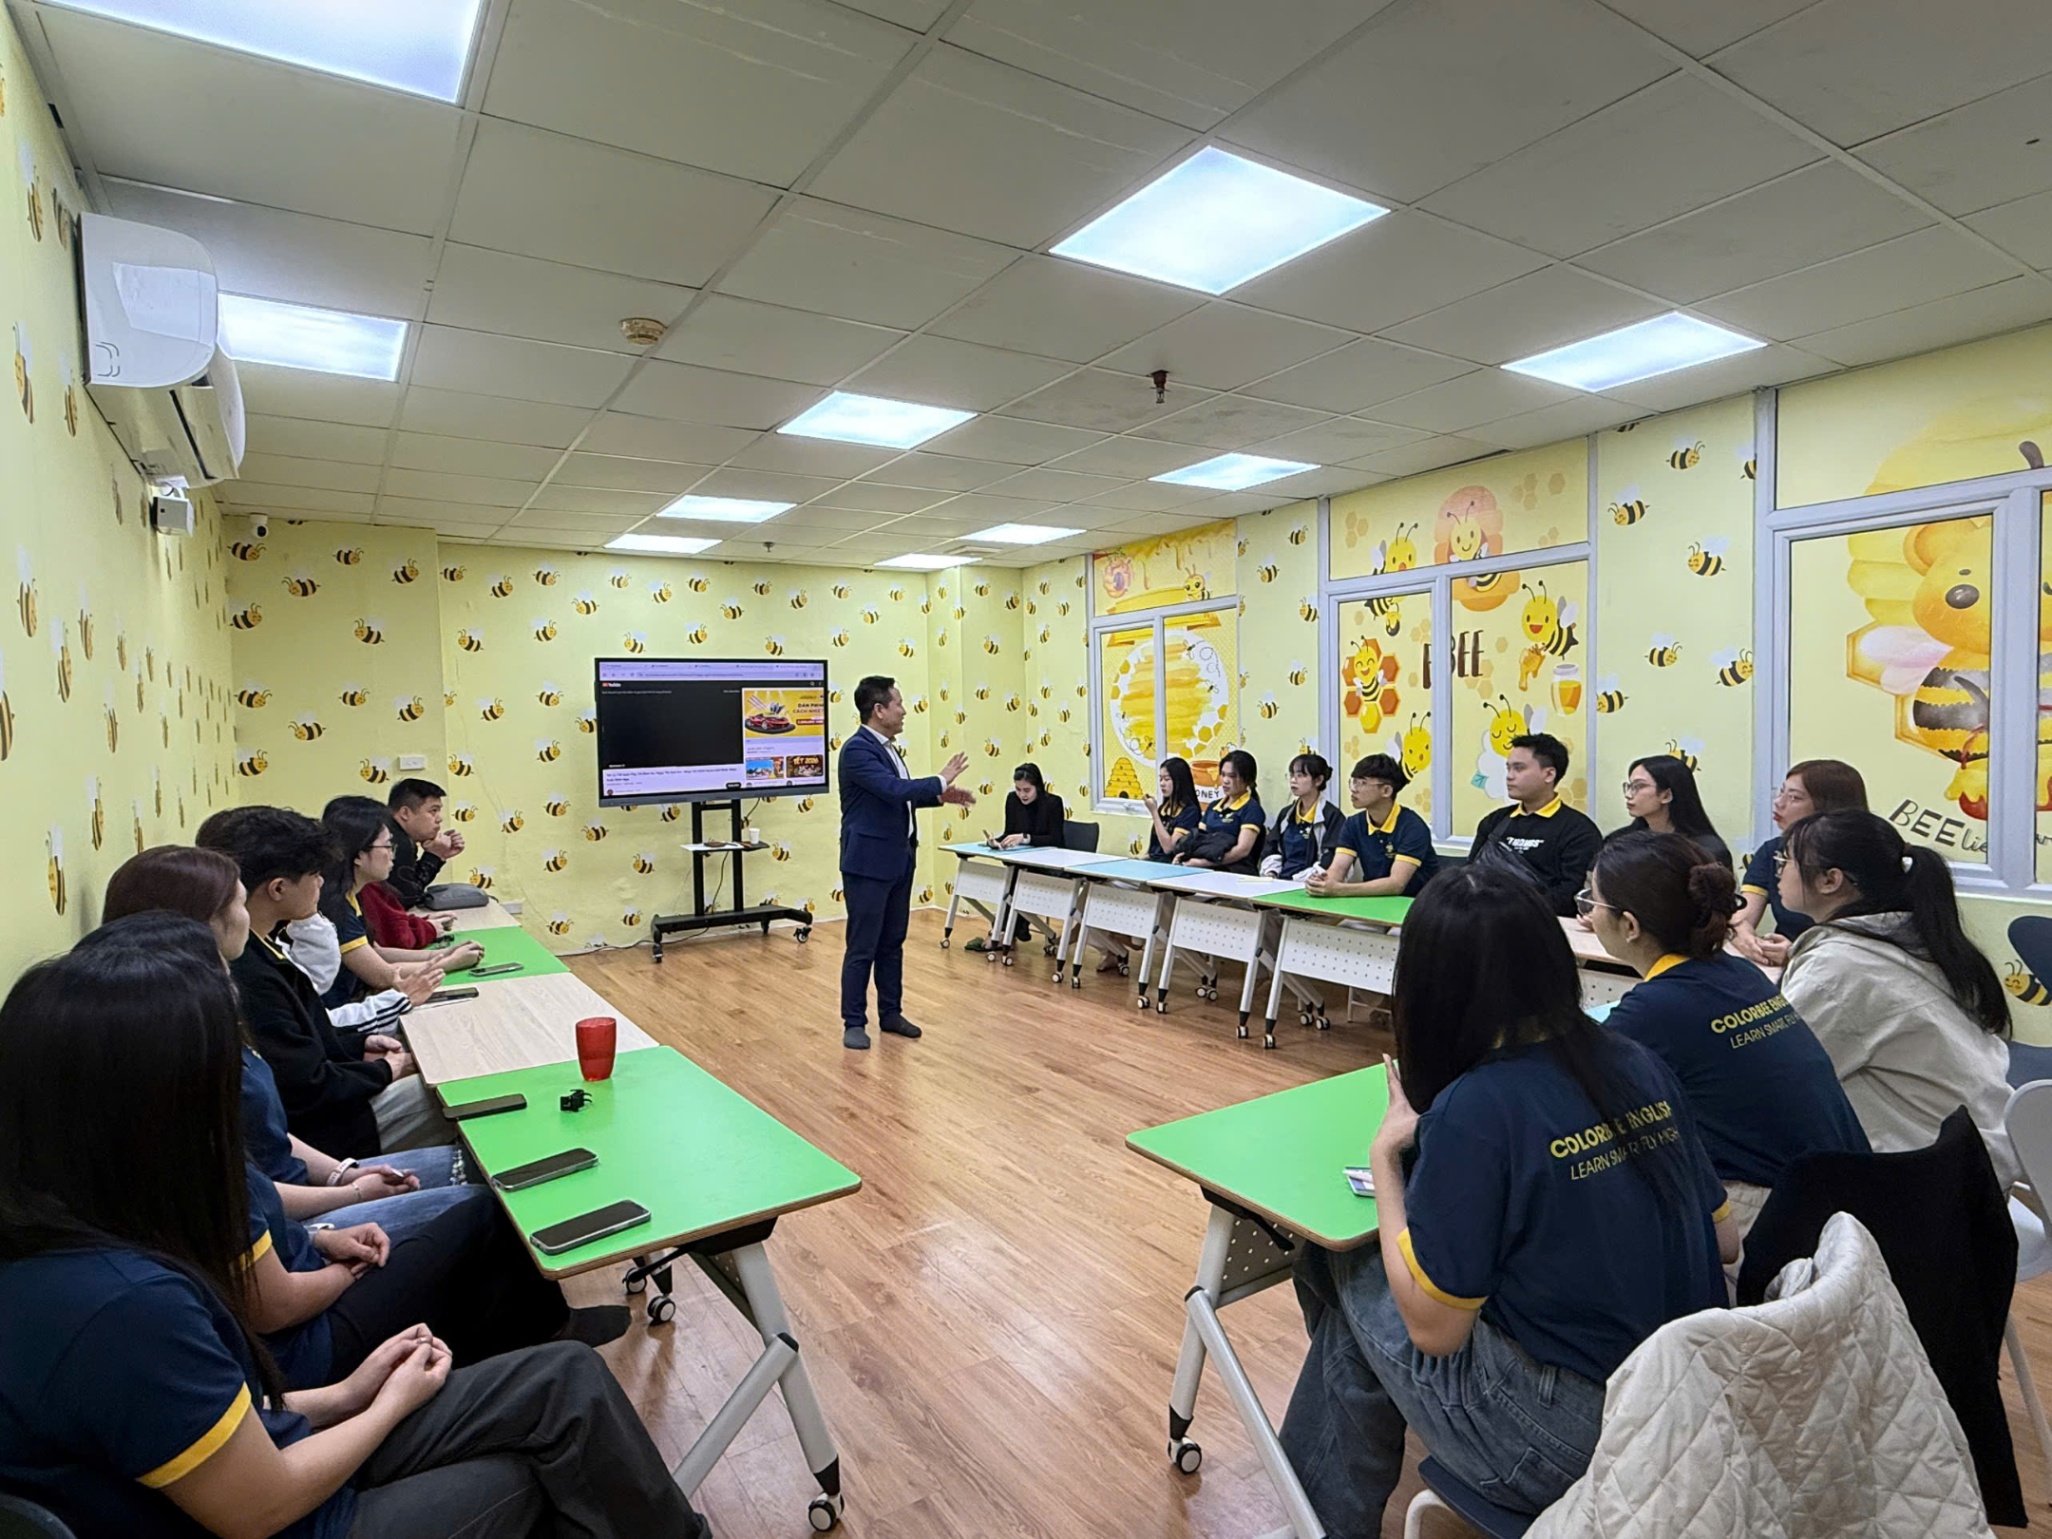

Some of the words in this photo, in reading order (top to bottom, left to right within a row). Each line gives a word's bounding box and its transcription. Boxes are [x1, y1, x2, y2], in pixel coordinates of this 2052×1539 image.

[1195, 789, 1220, 798] ONEY
[1711, 1001, 1773, 1034] COLORBEE
[1730, 1026, 1766, 1049] LEARN
[1550, 1118, 1628, 1158] COLORBE
[1570, 1153, 1611, 1180] LEARN
